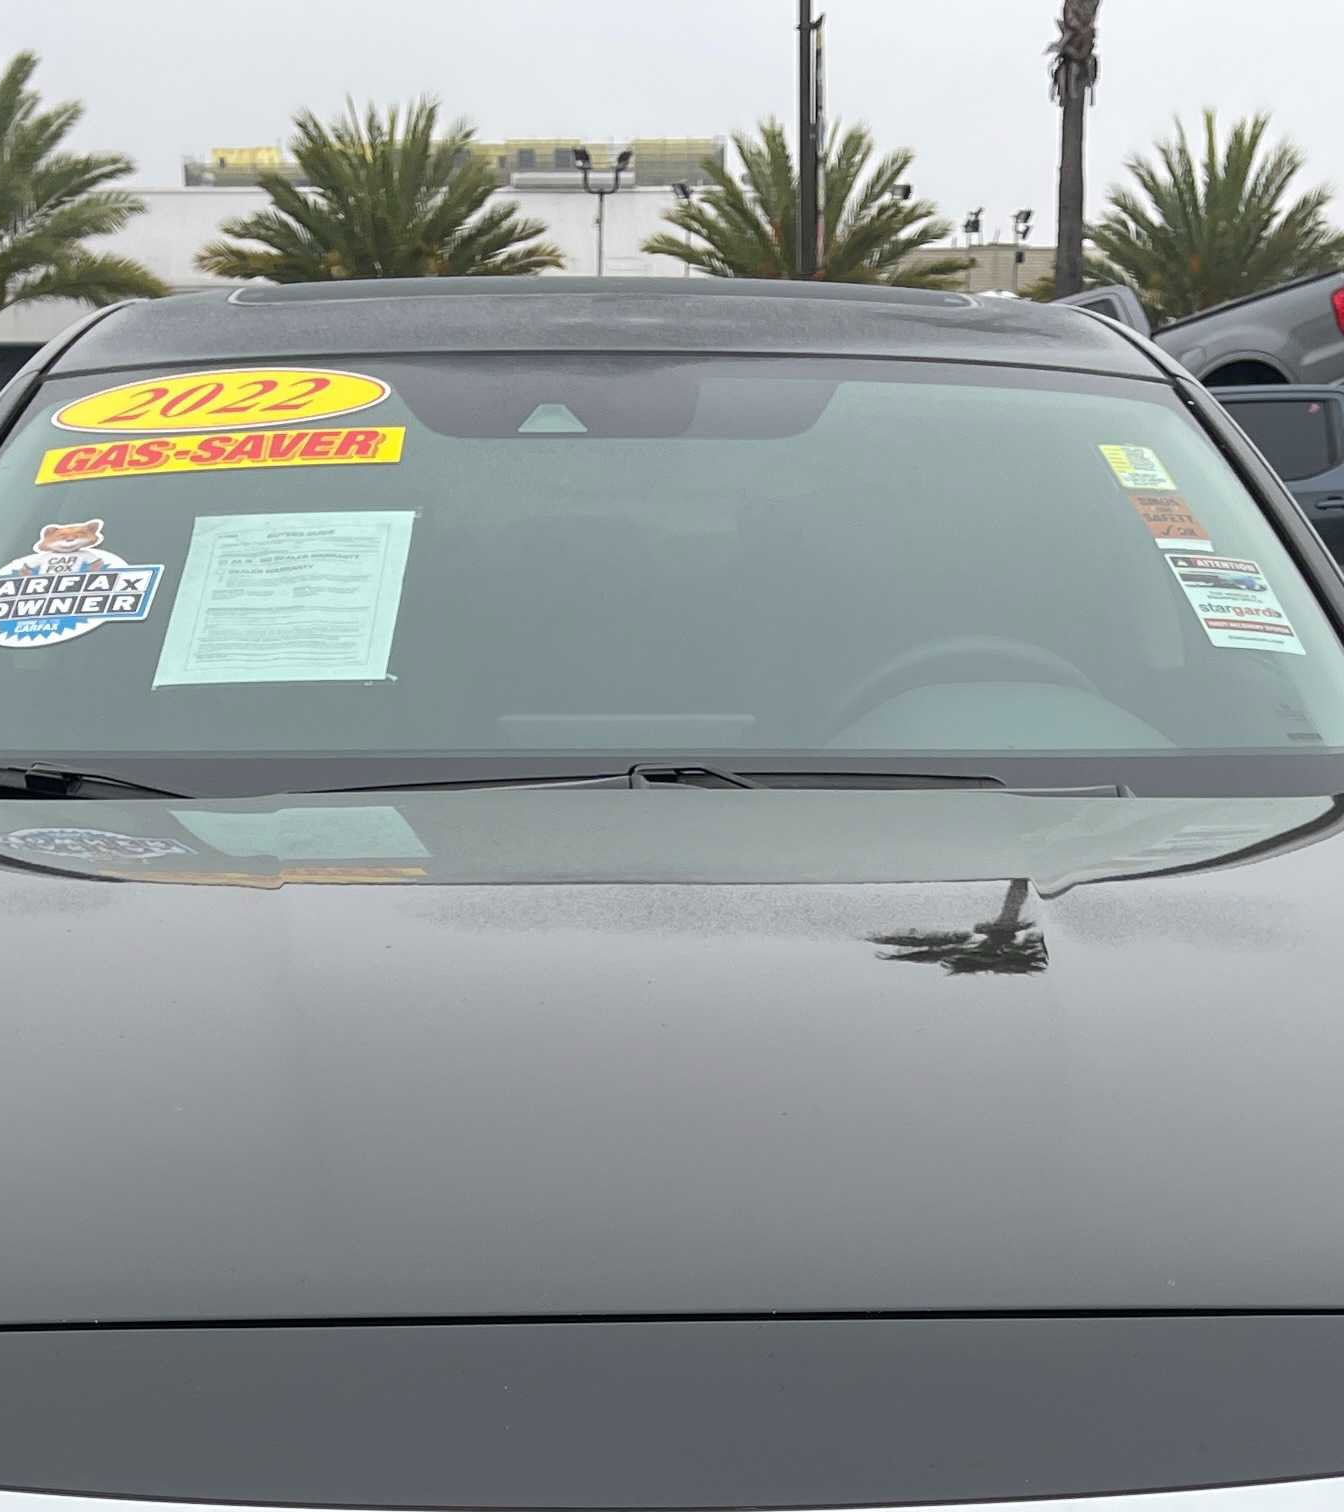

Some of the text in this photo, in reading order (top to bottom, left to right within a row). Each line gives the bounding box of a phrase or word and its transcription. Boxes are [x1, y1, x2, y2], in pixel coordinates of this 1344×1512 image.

[97, 378, 332, 424] 2022
[53, 430, 388, 476] GAS-SAVER
[46, 564, 73, 573] FOX
[47, 556, 78, 566] CAR
